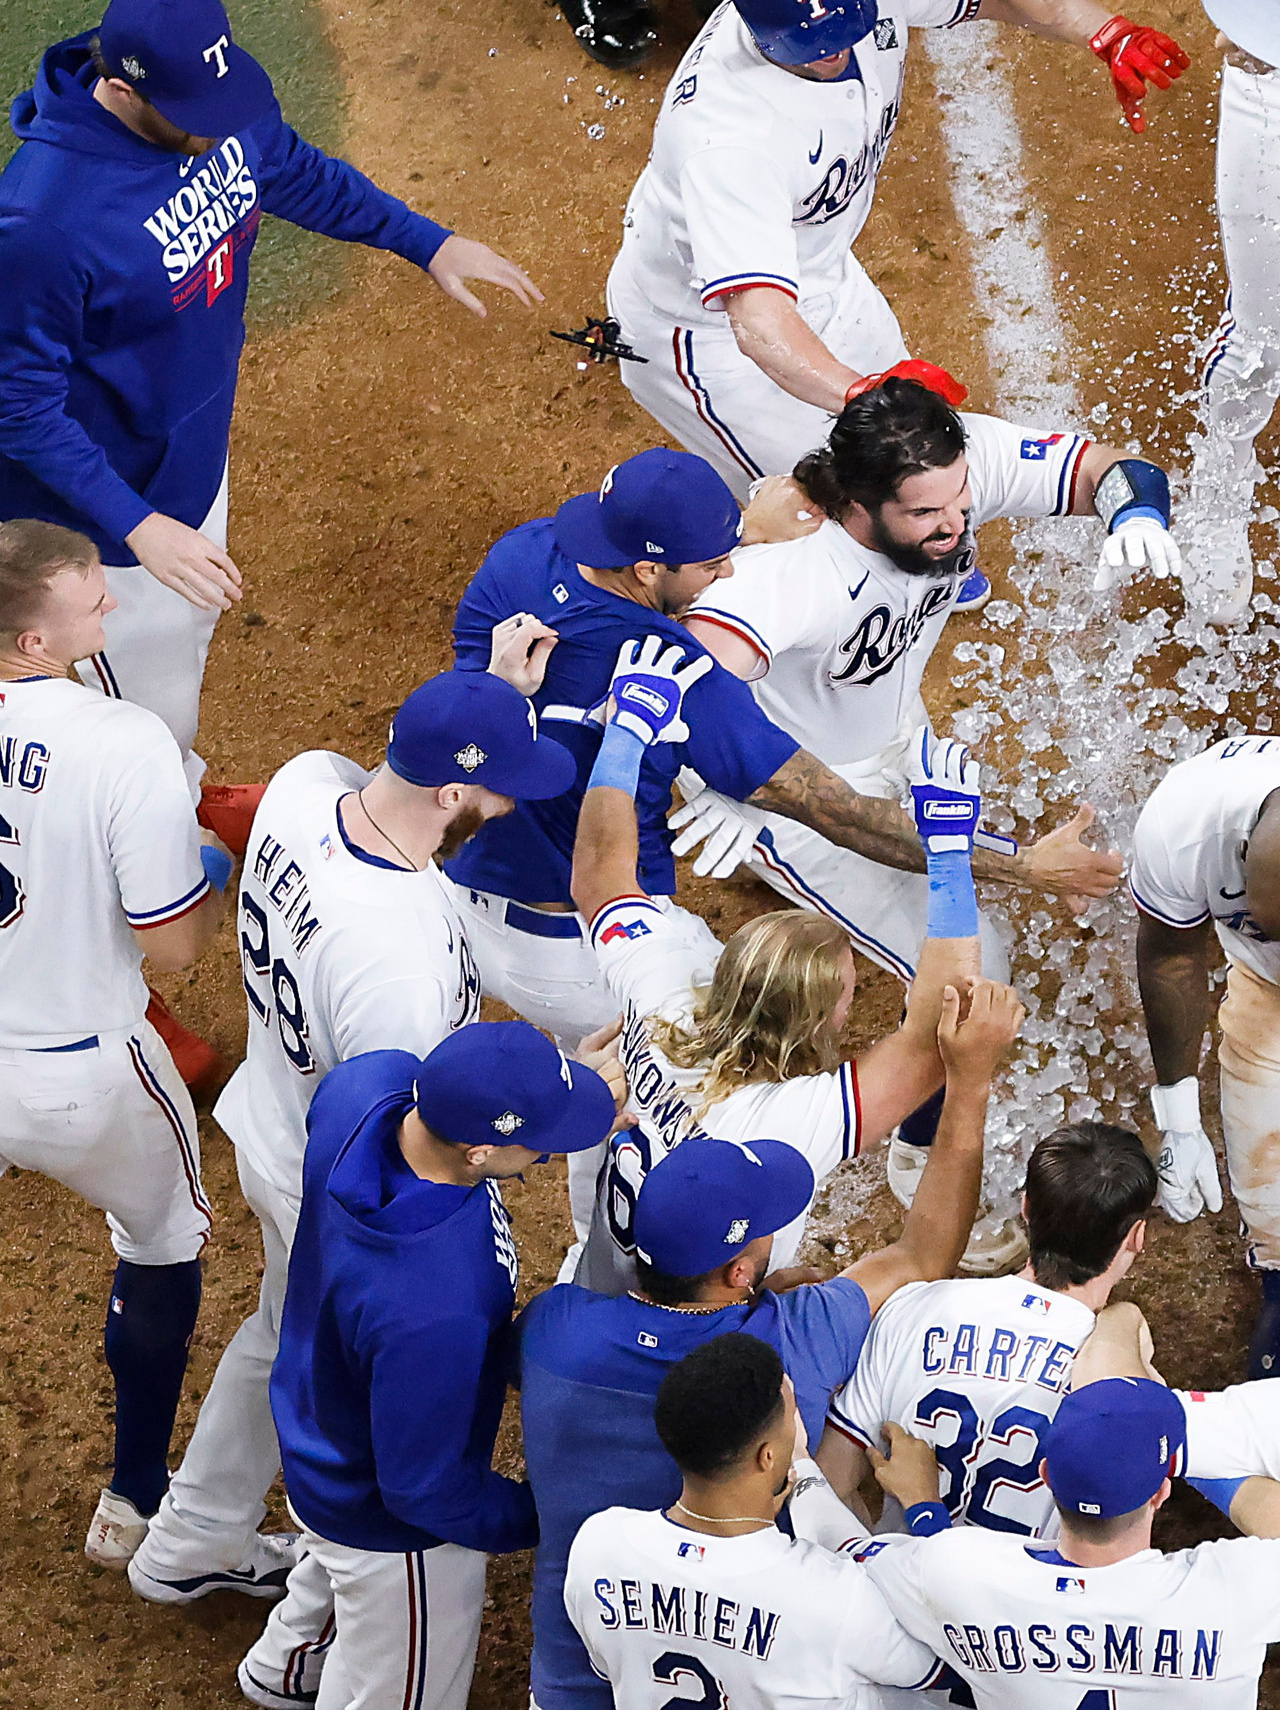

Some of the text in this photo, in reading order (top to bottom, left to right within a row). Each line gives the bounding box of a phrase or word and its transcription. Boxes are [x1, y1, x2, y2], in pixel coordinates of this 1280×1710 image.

[203, 35, 229, 78] T
[143, 137, 244, 247] WORLD
[162, 166, 257, 283] SERIES
[207, 242, 230, 289] T
[927, 803, 971, 817] Franklin
[253, 834, 322, 959] HEIM
[237, 891, 316, 1076] 28
[923, 1324, 1077, 1395] CARTE
[914, 1387, 1053, 1537] 32
[594, 1578, 781, 1661] SEMIEN
[942, 1624, 1223, 1680] GROSSMAN
